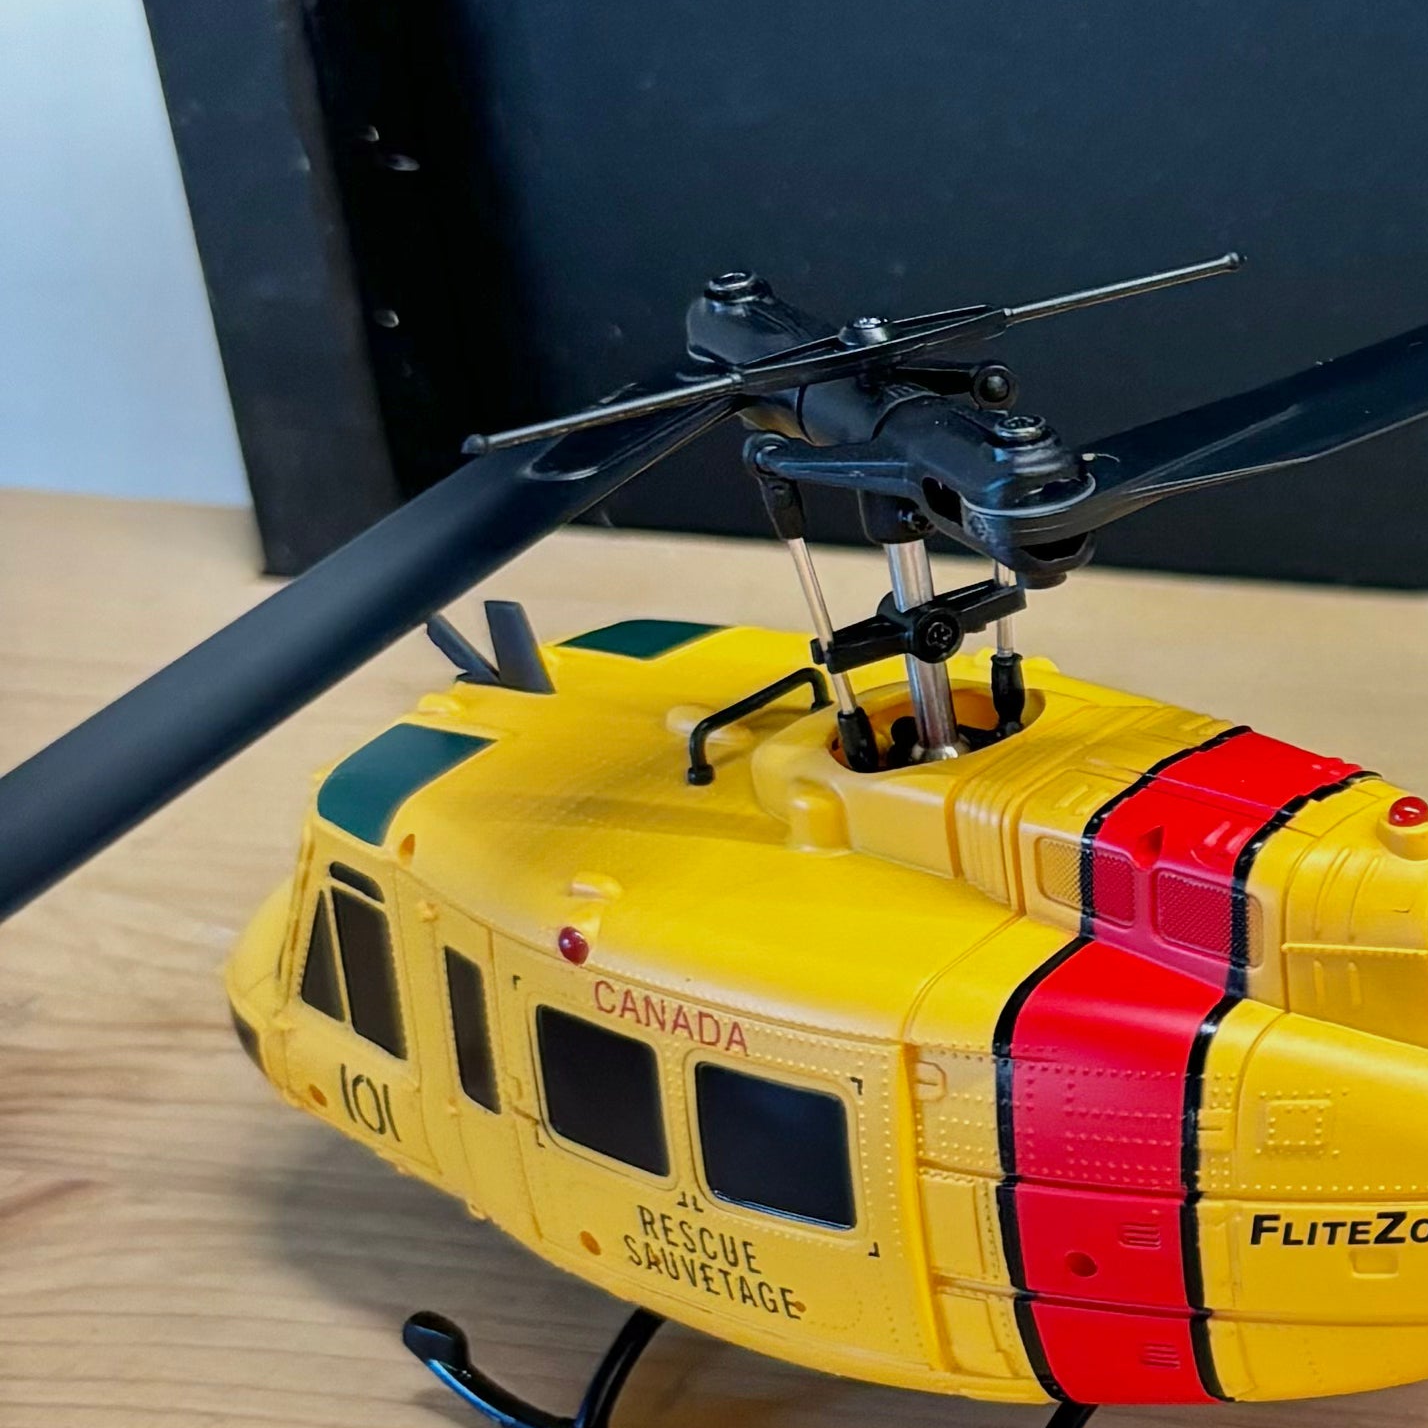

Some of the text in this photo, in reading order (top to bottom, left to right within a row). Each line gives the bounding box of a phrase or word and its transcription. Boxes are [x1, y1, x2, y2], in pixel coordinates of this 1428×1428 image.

[594, 980, 750, 1055] CANADA
[339, 1063, 401, 1143] 101
[622, 1233, 802, 1320] SAUVETAGE
[638, 1204, 762, 1275] RESCUE
